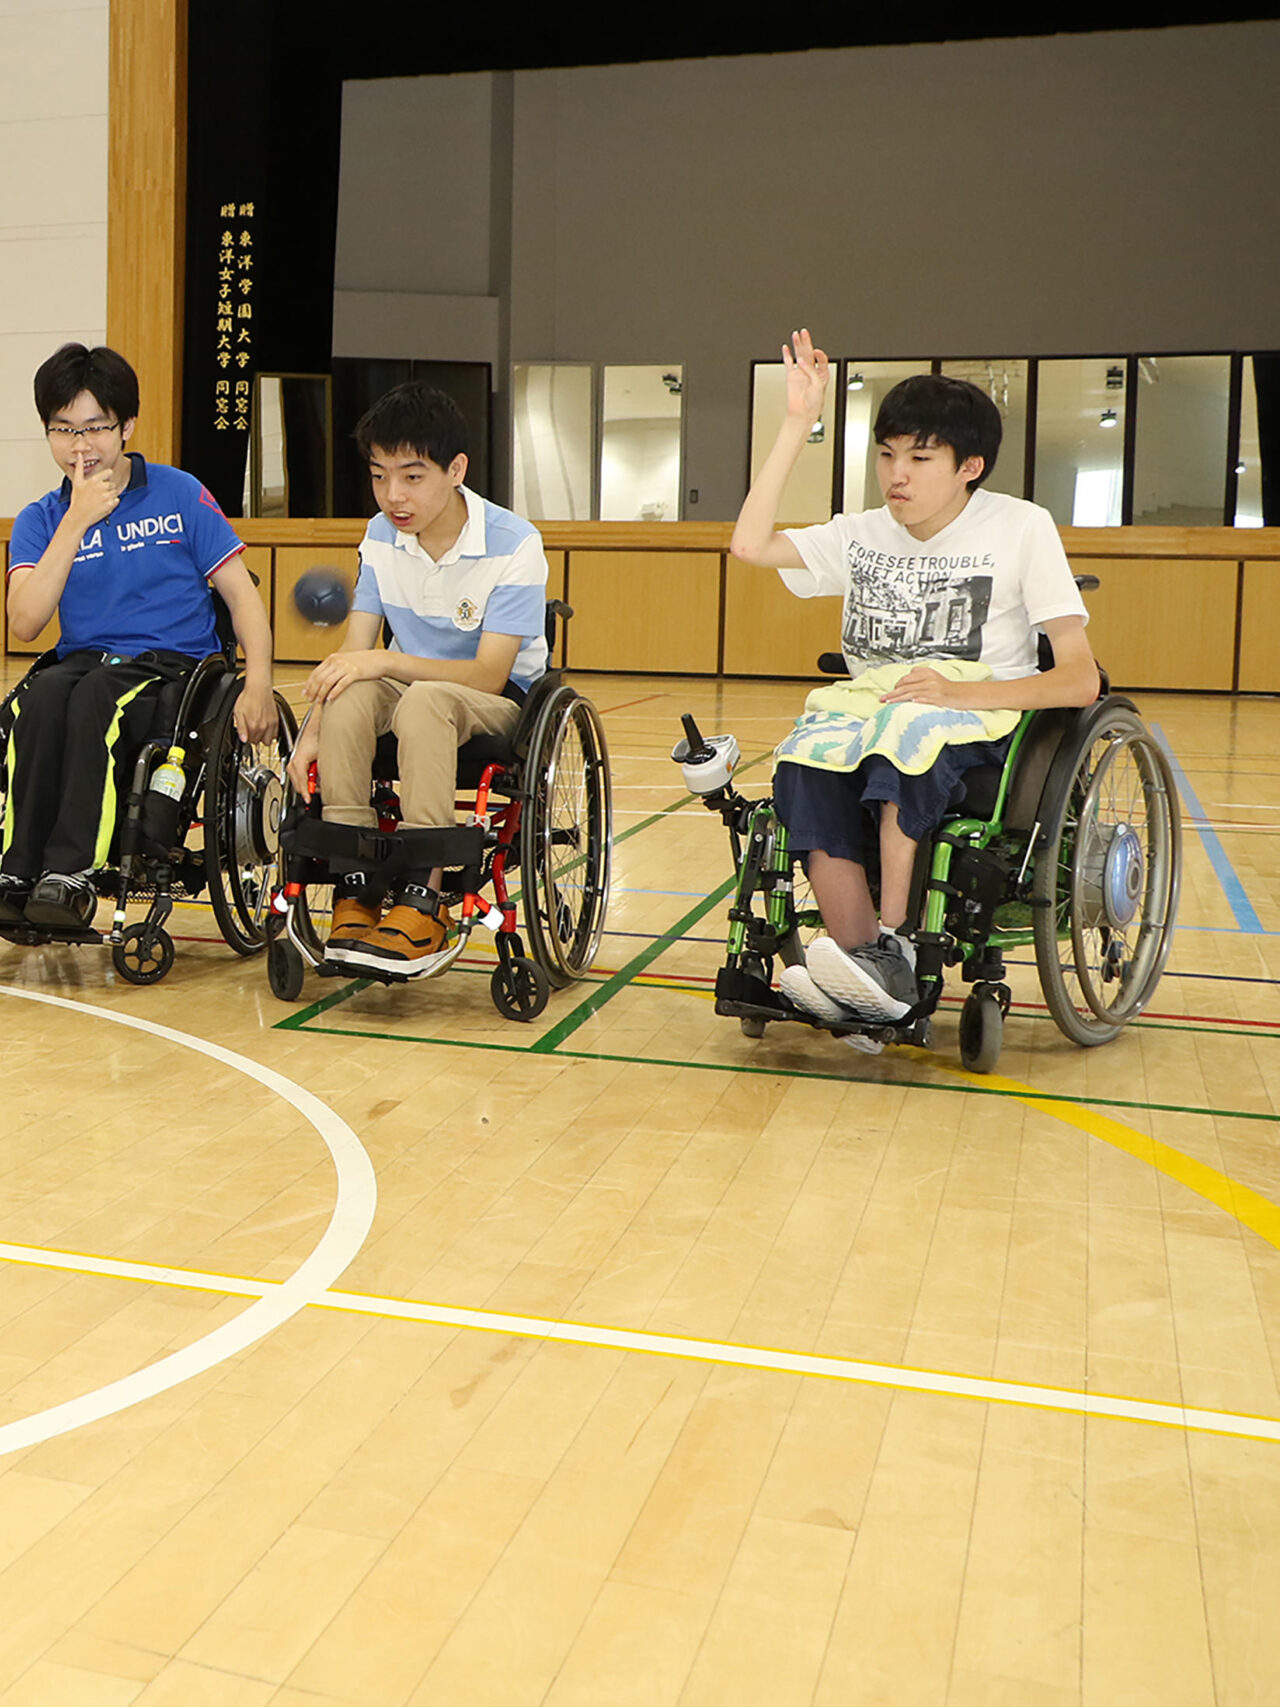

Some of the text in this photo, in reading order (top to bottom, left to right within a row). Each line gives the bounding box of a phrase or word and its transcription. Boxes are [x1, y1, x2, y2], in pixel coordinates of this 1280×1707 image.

[116, 513, 183, 541] UNDICI
[847, 540, 997, 571] FORESEE TROUBLE,
[893, 571, 953, 585] ACTION
